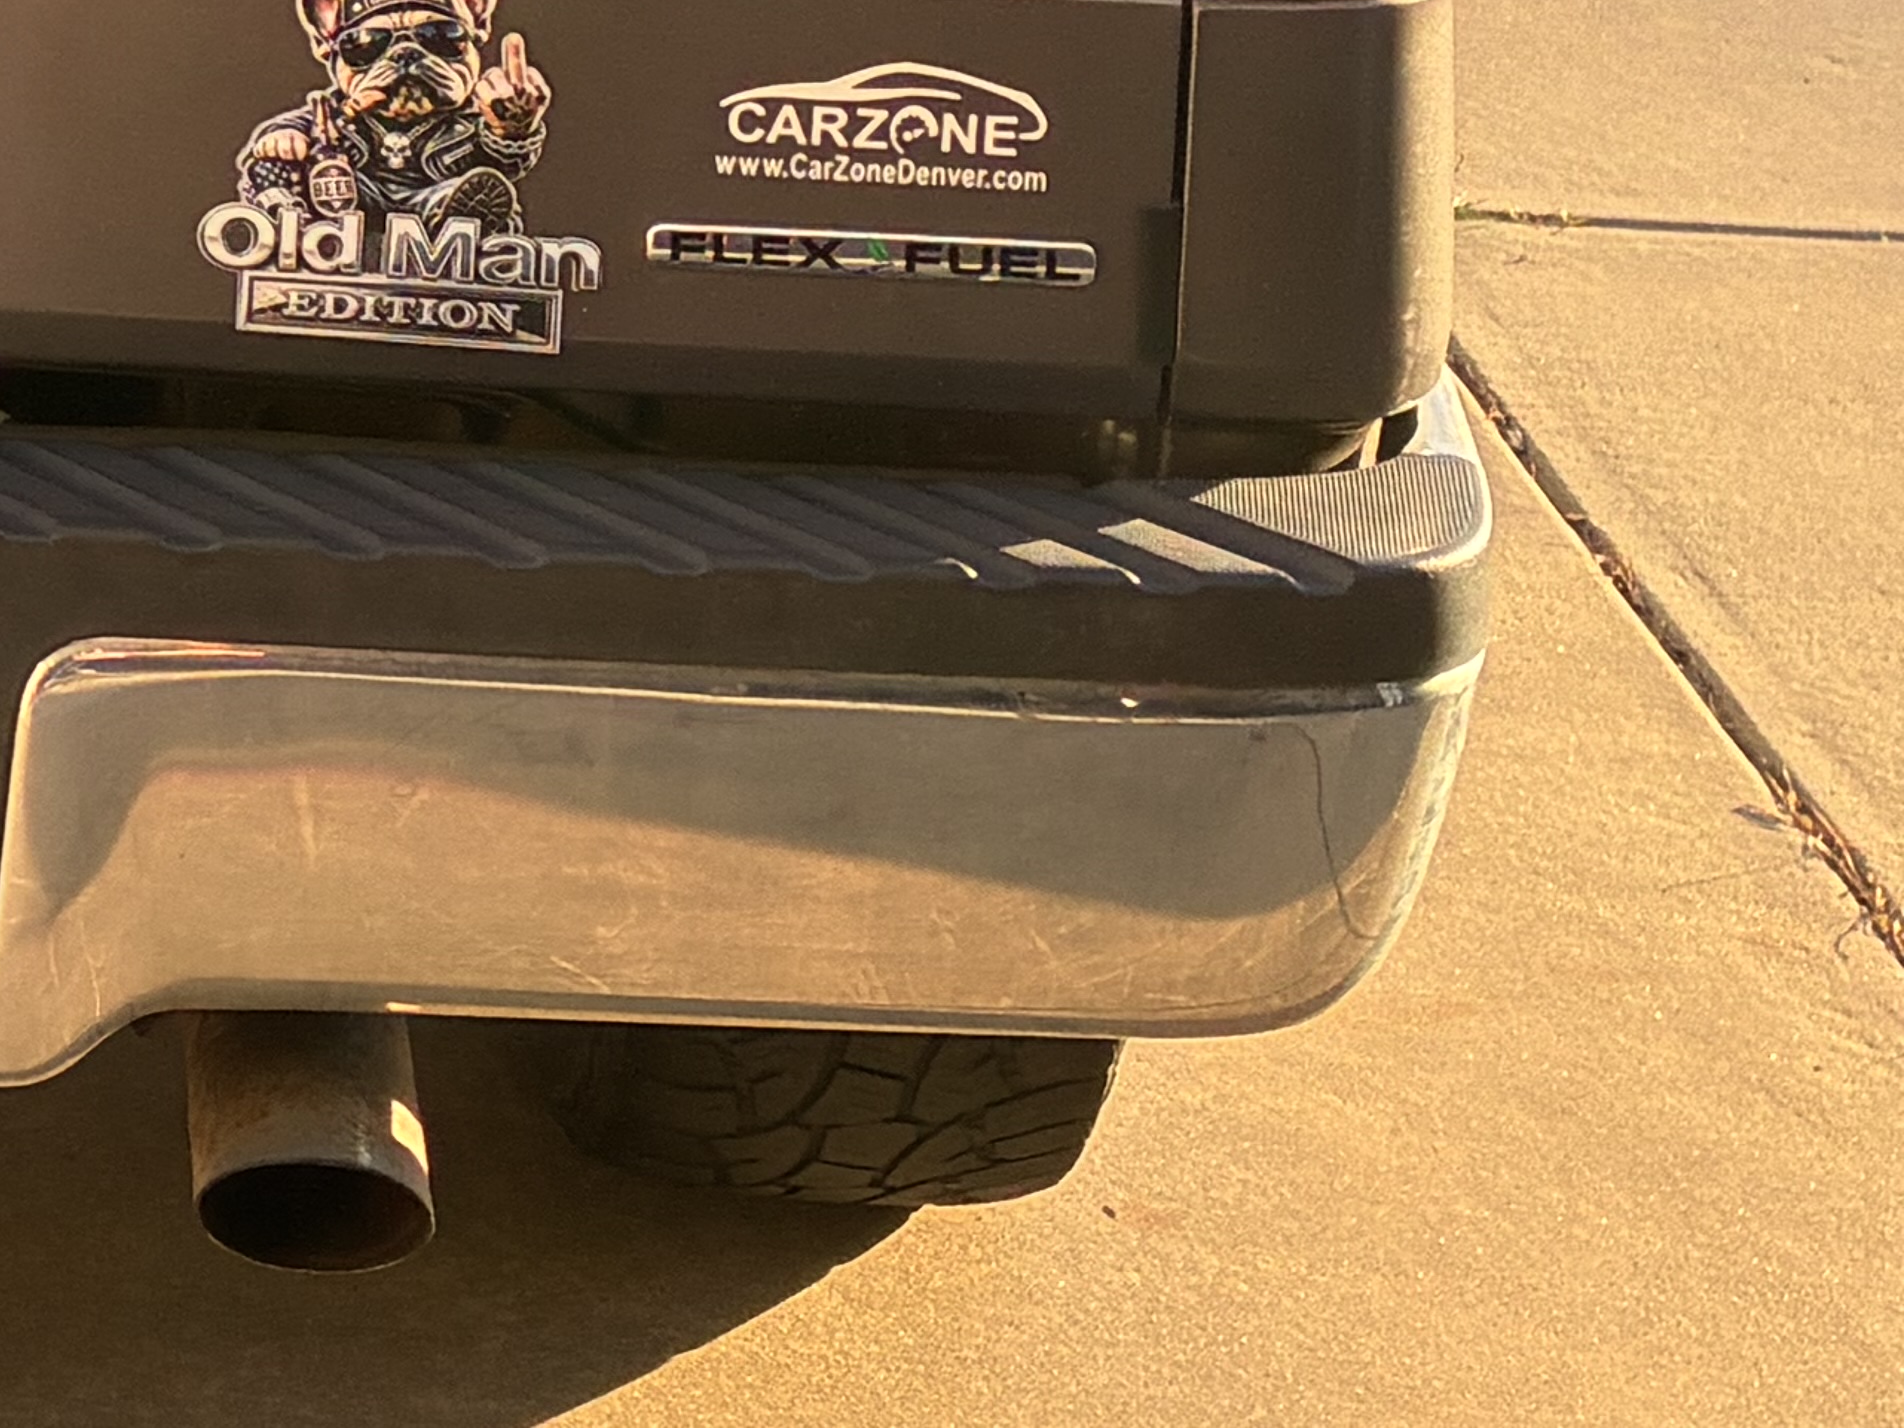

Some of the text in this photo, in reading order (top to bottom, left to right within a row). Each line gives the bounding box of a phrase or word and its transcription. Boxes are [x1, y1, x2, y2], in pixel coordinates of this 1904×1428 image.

[727, 101, 1020, 157] CARZONE
[714, 152, 1048, 192] www.CarZoneDenver.com
[197, 202, 603, 292] Old Man
[670, 231, 1083, 282] FLEX FUEL
[281, 289, 521, 335] EDITION
